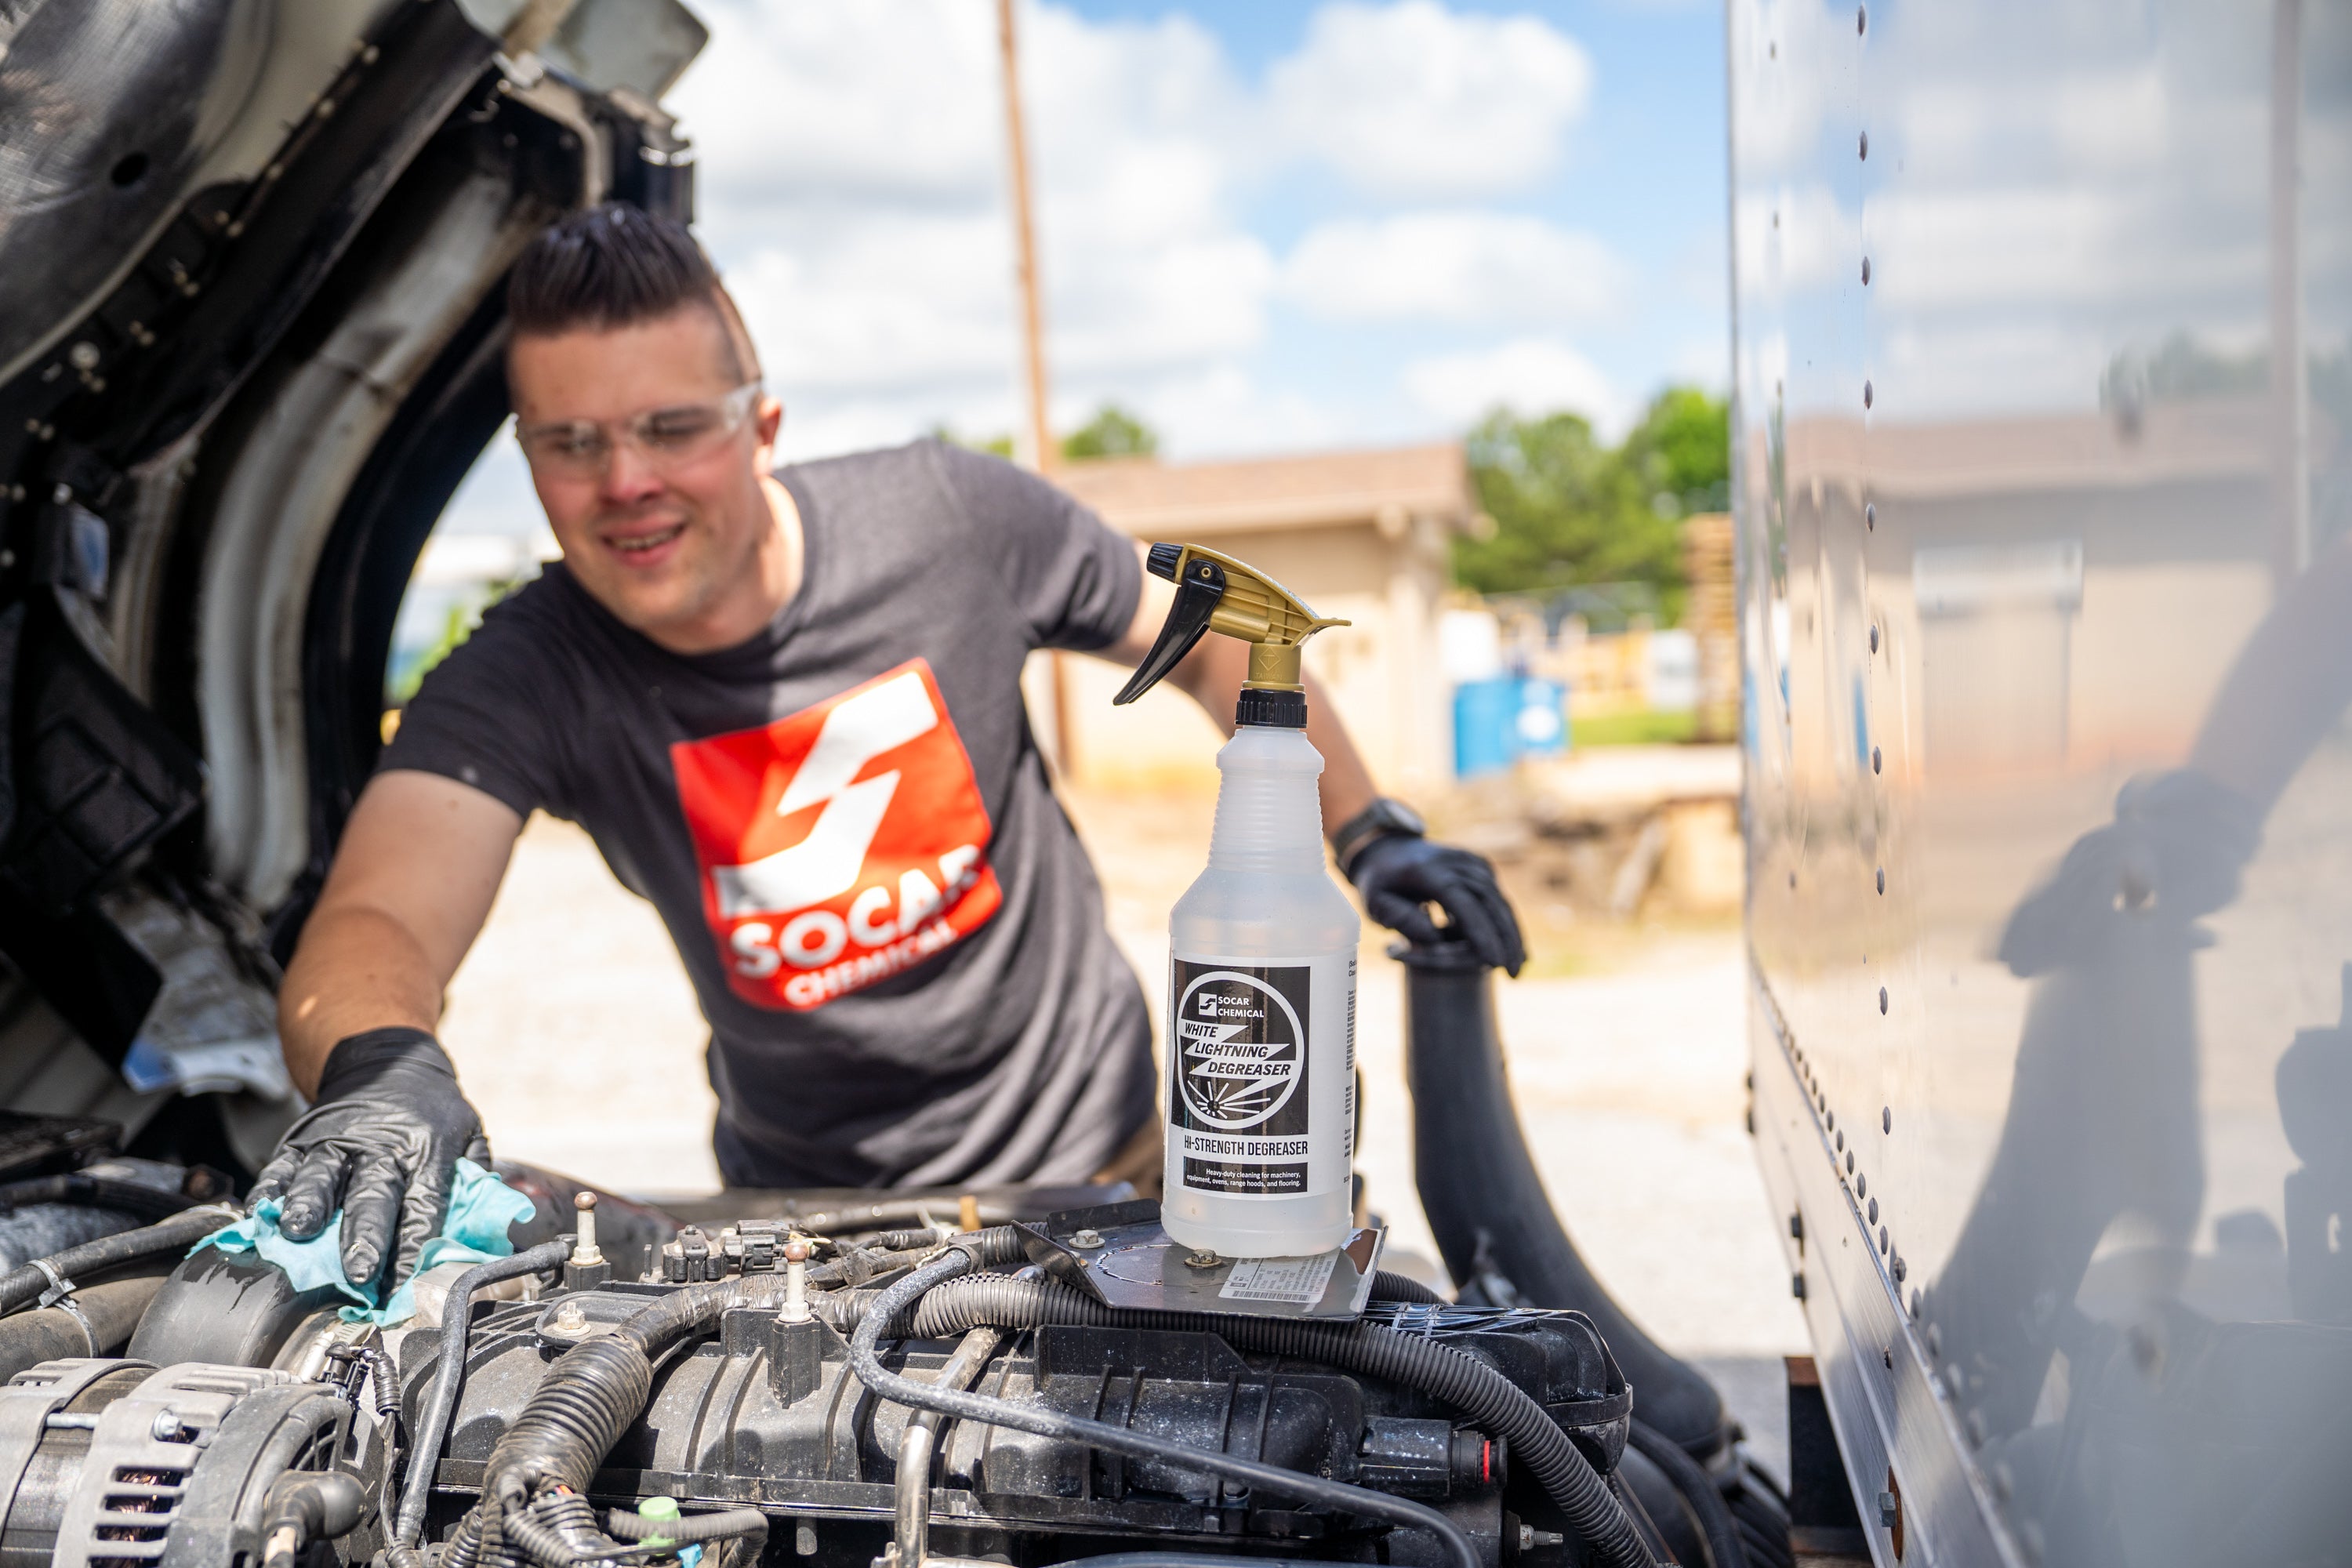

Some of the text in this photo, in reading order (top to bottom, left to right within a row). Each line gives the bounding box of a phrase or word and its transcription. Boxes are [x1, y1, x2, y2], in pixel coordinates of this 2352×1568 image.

[1255, 672, 1283, 681] TAIWAN
[1218, 996, 1250, 1006] SOCAR
[1218, 1008, 1265, 1018] CHEMICAL
[1185, 1022, 1218, 1038] WHITE
[1194, 1042, 1269, 1058] LIGHTNING
[1207, 1062, 1291, 1076] DEGREASER
[1184, 1134, 1308, 1156] HI-STRENGTH DEGREASER
[1186, 1174, 1212, 1185] equipment,
[1206, 1168, 1236, 1179] Heavy-duty
[1236, 1171, 1261, 1180] cleaning
